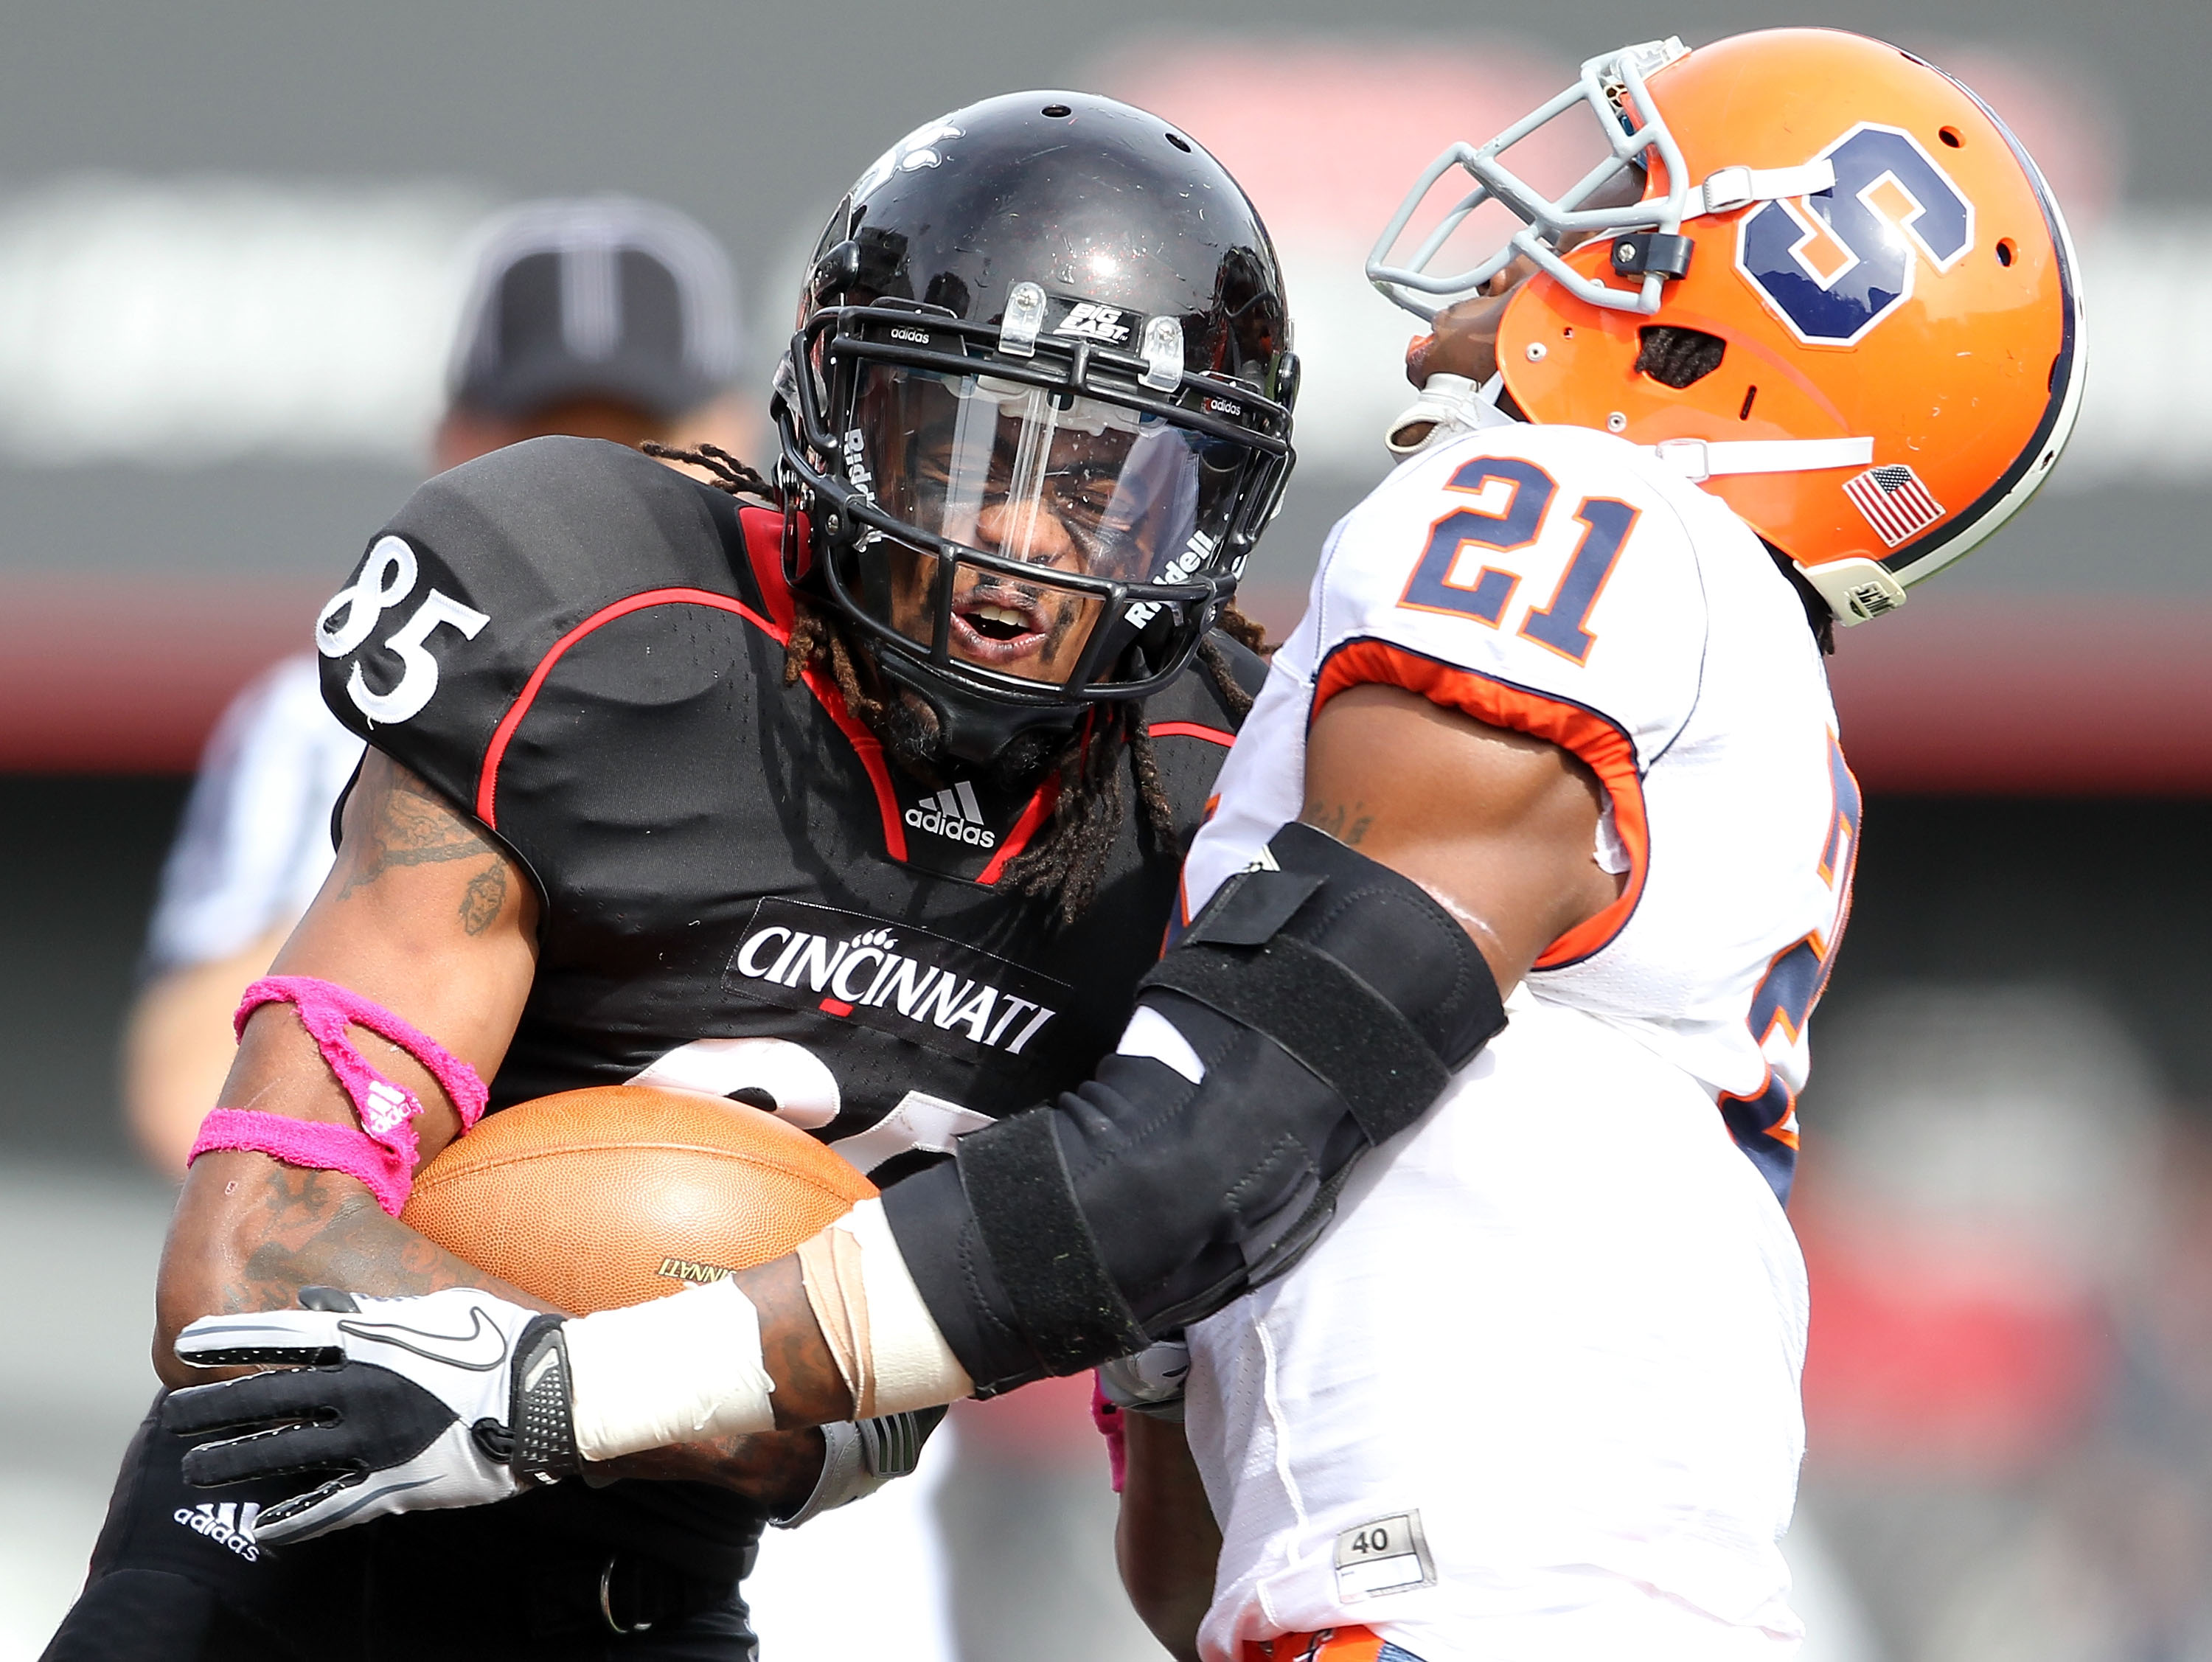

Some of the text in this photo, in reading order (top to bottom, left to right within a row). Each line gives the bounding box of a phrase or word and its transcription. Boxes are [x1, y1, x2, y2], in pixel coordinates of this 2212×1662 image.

[1060, 316, 1130, 340] EAST
[1070, 302, 1123, 324] BIG
[891, 328, 930, 344] adidas
[1210, 399, 1241, 416] adidas
[1396, 454, 1643, 668] 21
[315, 535, 491, 725] 85
[905, 807, 995, 849] adidas
[737, 926, 1056, 1056] CINCINNATI
[173, 1508, 260, 1562] adidas
[1352, 1527, 1388, 1554] 40
